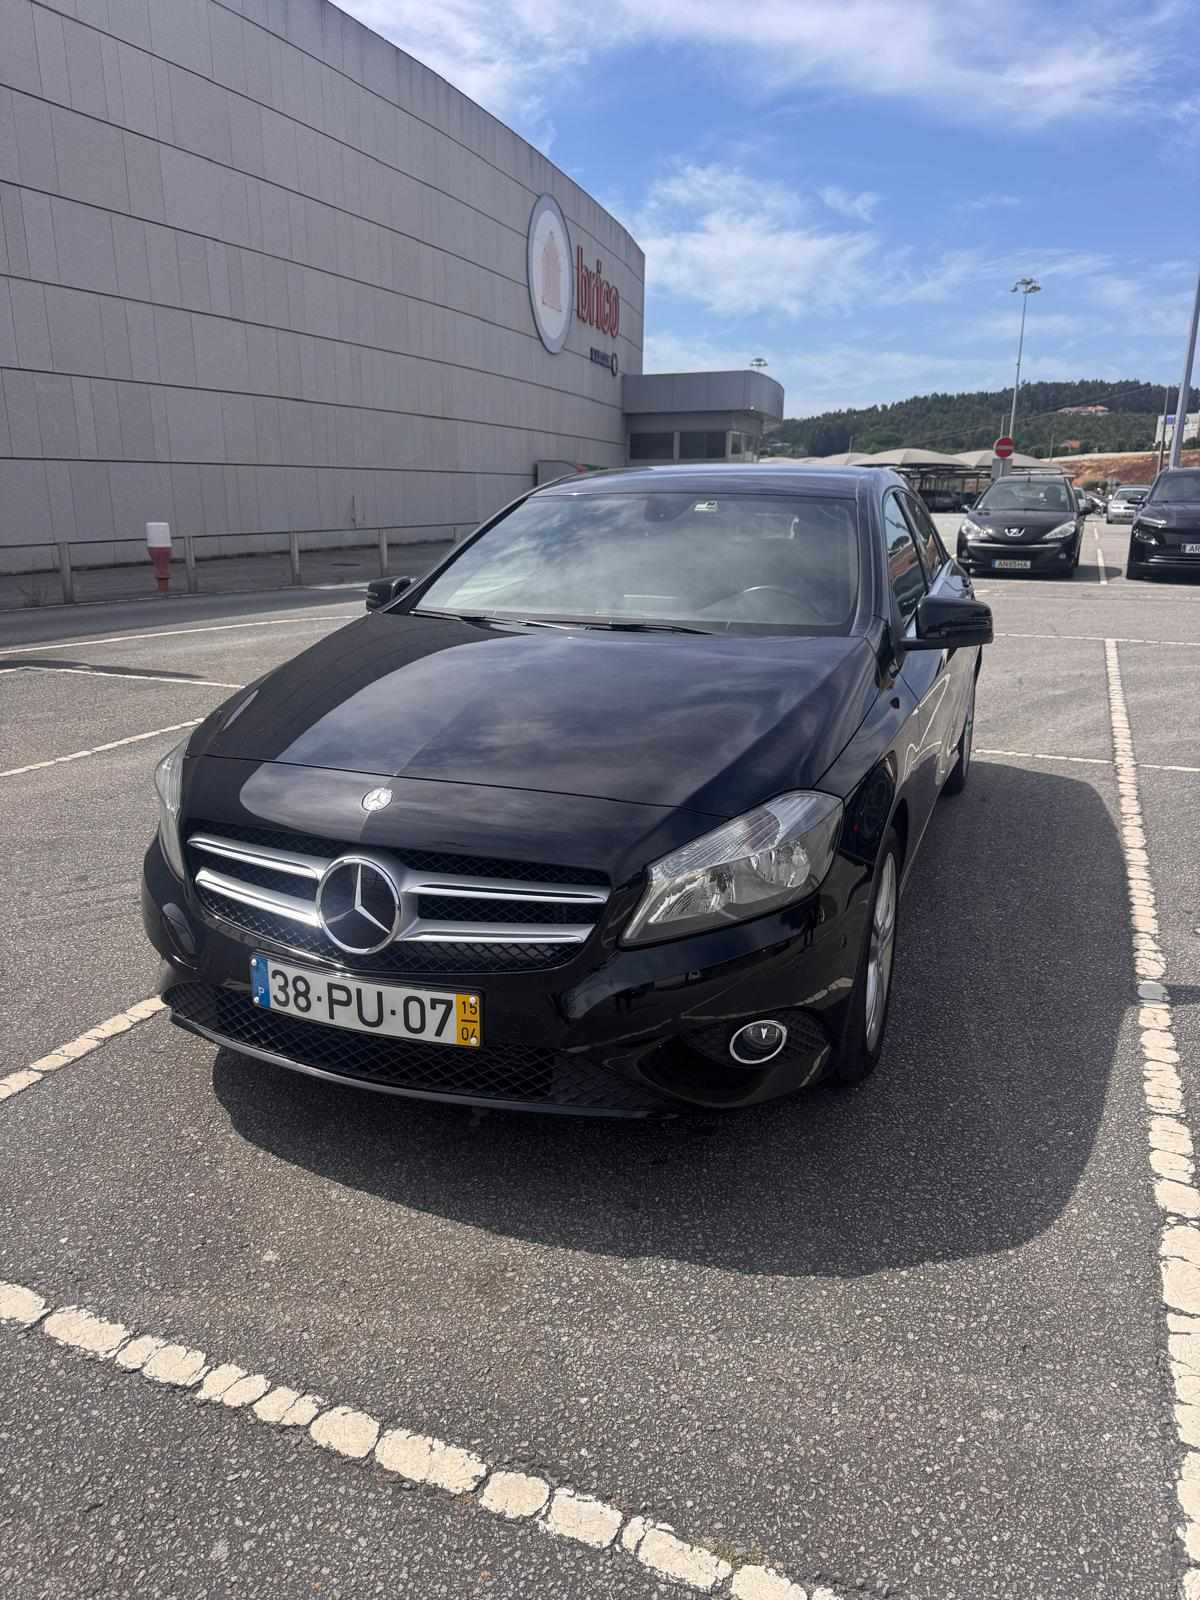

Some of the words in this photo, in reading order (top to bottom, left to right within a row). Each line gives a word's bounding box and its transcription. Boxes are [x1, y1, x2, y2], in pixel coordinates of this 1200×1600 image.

[576, 245, 619, 338] brico
[258, 986, 264, 996] P
[462, 1000, 478, 1015] 15
